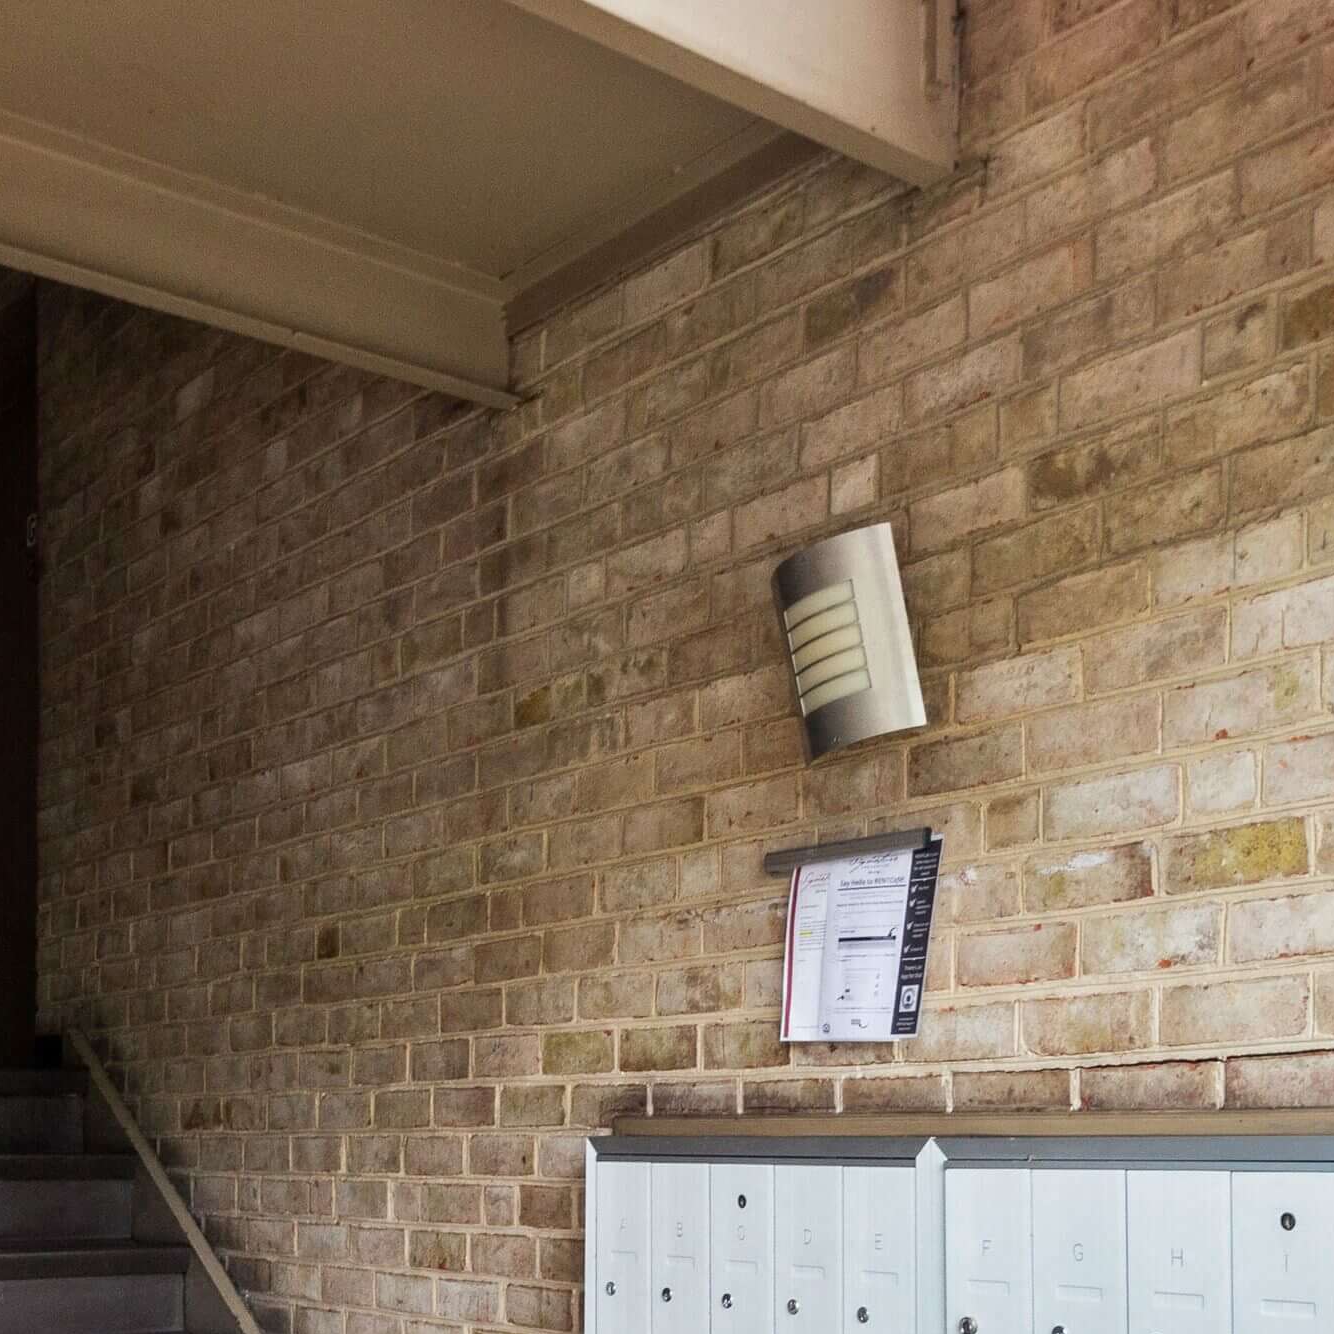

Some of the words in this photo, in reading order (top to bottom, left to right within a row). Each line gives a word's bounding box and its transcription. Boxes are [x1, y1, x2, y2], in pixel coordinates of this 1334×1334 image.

[803, 1228, 812, 1245] D
[874, 1233, 883, 1250] E
[982, 1239, 992, 1257] F
[1073, 1243, 1084, 1262] G
[1171, 1247, 1185, 1268] H
